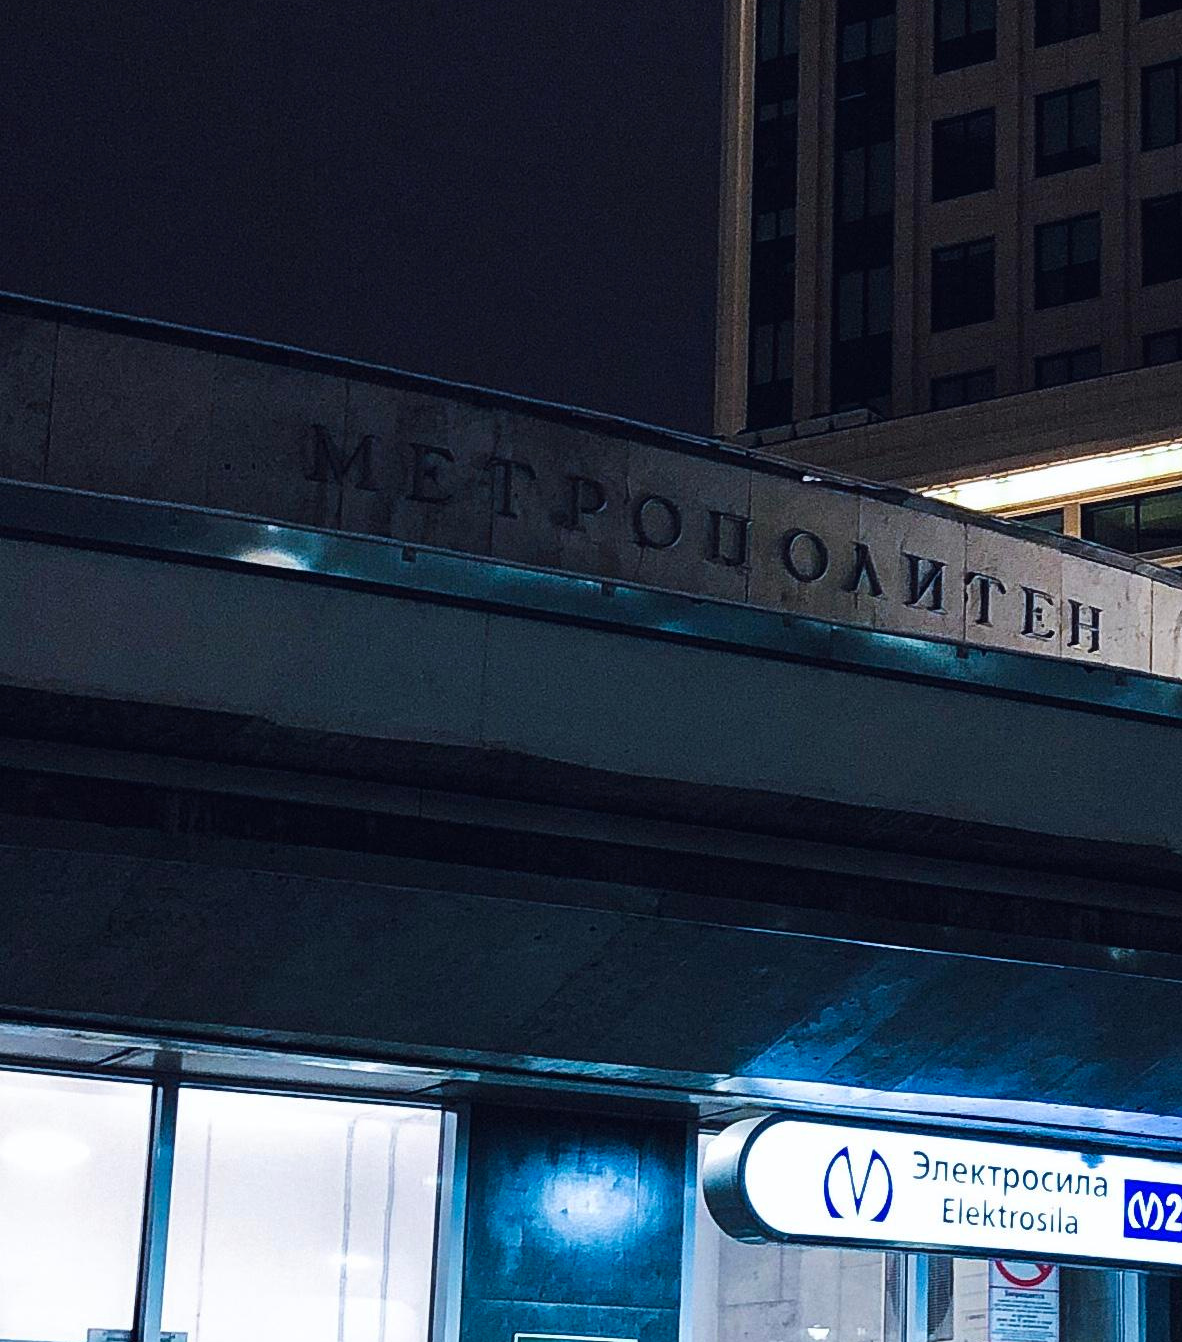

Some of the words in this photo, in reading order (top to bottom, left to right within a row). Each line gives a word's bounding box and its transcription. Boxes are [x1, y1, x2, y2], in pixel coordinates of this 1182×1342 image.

[304, 422, 1104, 654] МЕТРОПОЛИТЕН
[913, 1150, 1108, 1197] Электросила
[943, 1198, 1079, 1235] Elektrosila
